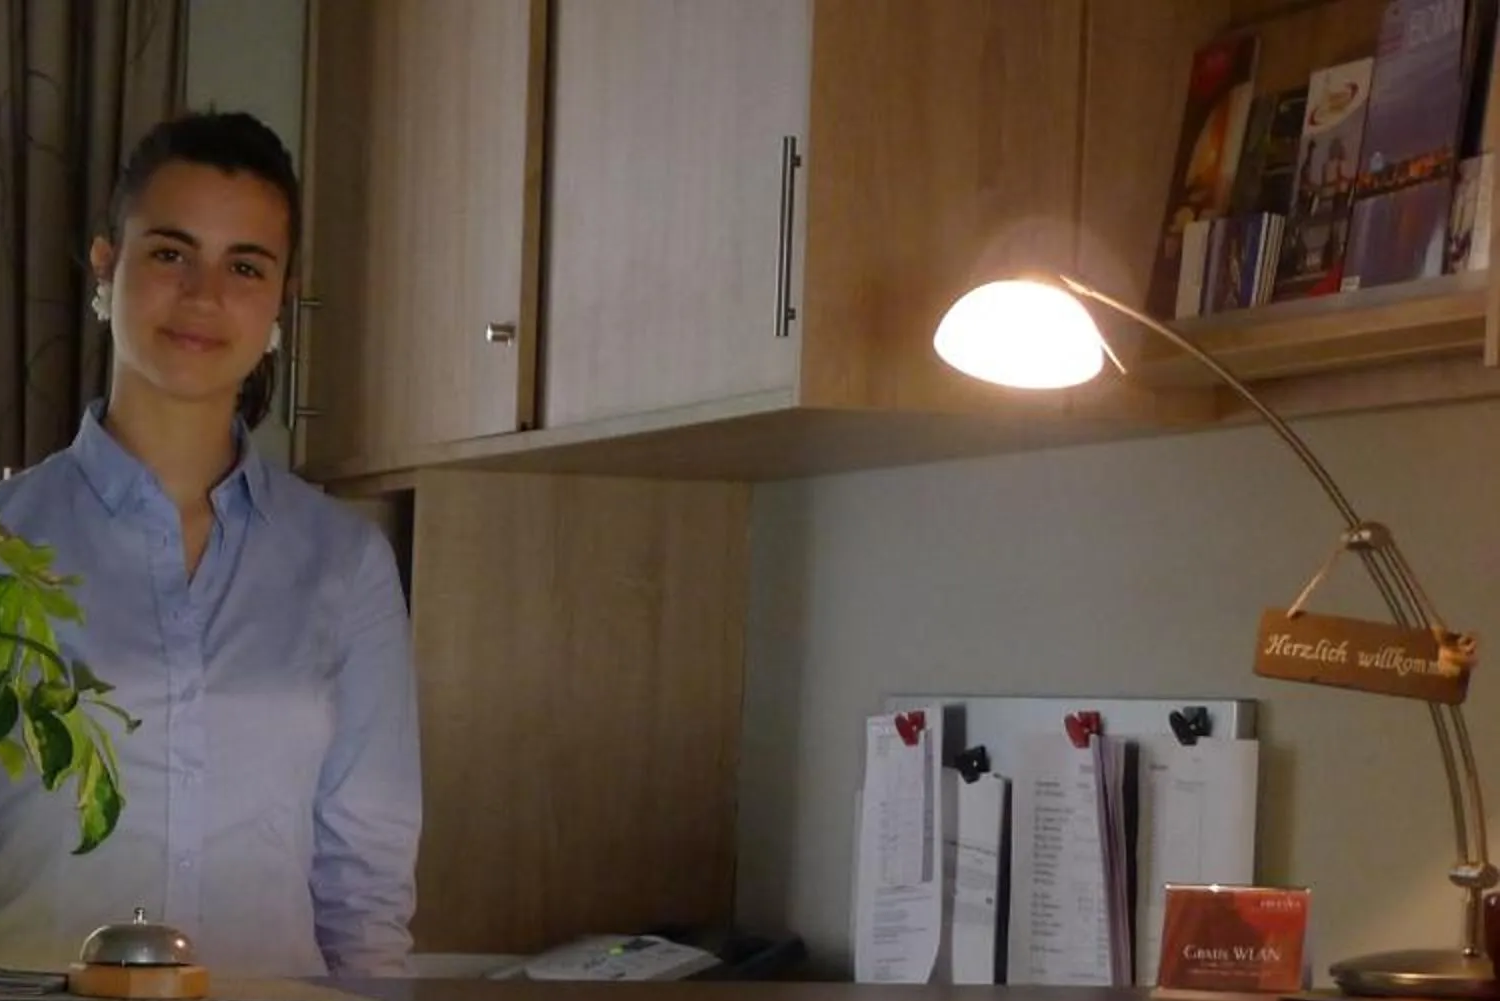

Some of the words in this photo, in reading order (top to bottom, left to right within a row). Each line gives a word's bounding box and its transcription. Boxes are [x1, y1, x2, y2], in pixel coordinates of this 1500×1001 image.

[1265, 634, 1348, 662] Herzlich
[1358, 646, 1442, 676] willkomm
[1233, 944, 1281, 961] WLAN
